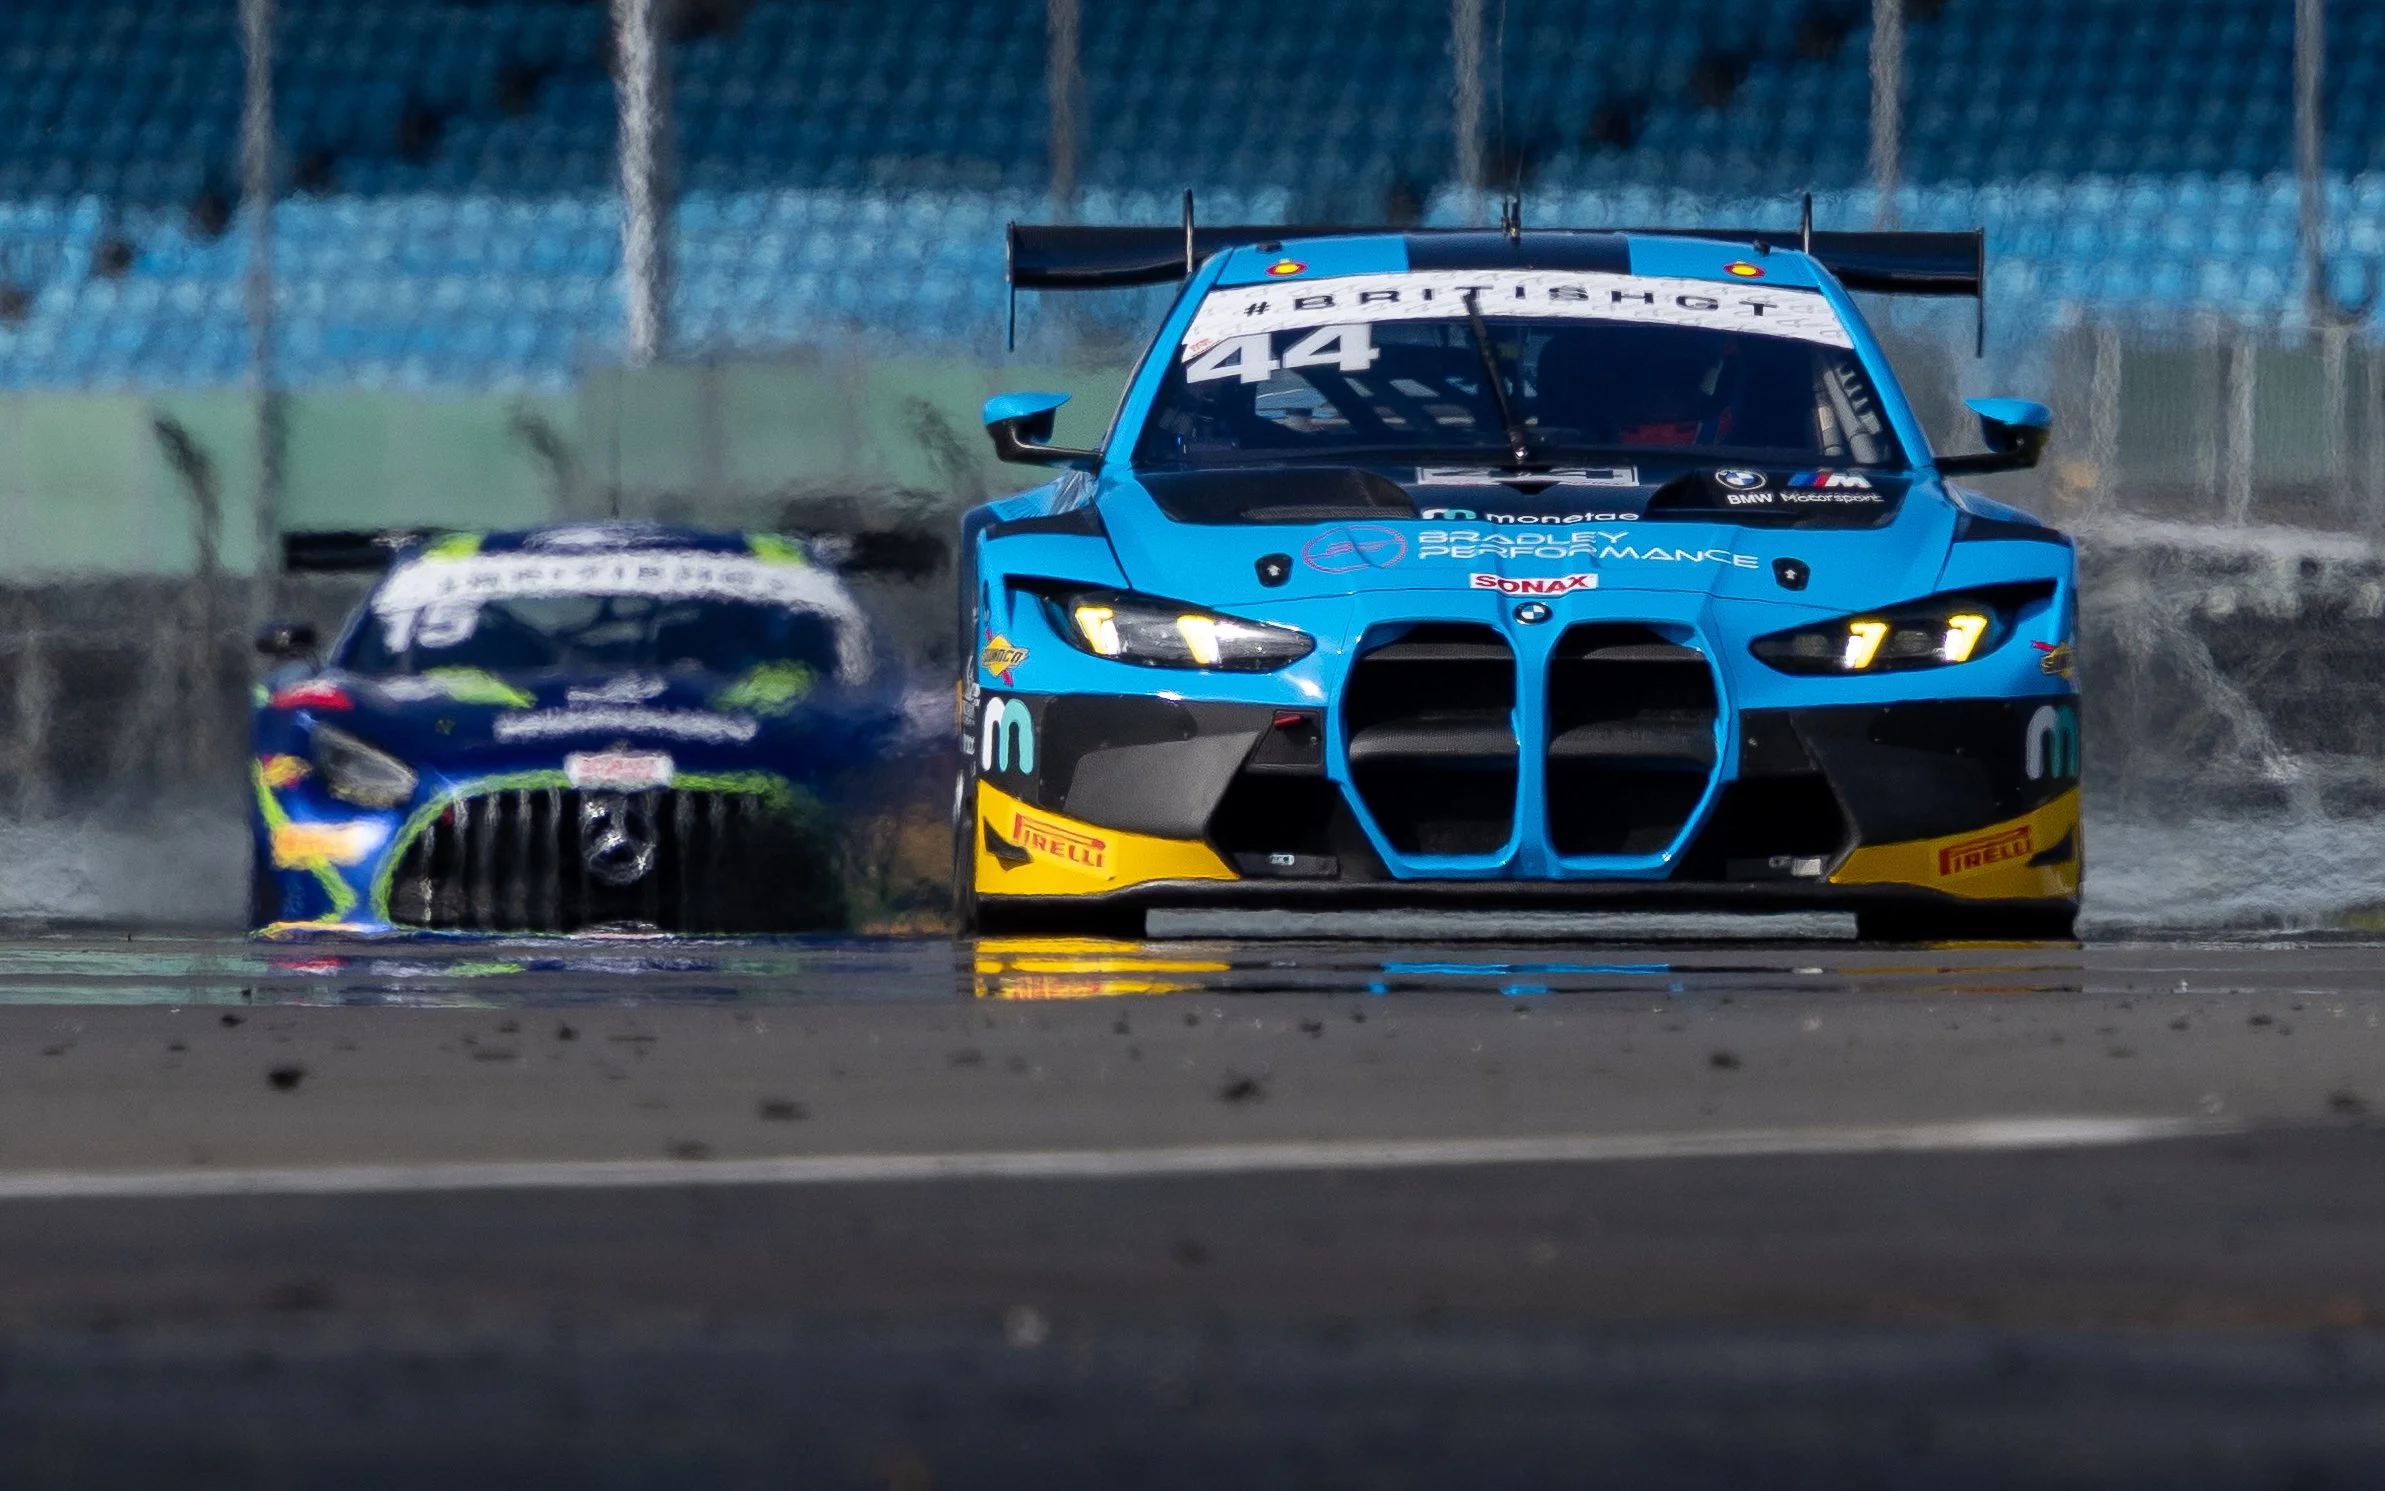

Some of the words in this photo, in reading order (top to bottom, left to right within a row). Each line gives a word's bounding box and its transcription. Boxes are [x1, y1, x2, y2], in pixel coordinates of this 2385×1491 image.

[1242, 284, 1778, 318] #BRITISHGT
[1187, 324, 1380, 385] 44
[1727, 493, 1773, 505] BMW
[1780, 492, 1885, 504] Motorsport
[1485, 511, 1640, 524] monetae
[1418, 530, 1630, 544] BRADLEY
[1418, 545, 1760, 569] PERFORMANCE
[1474, 574, 1589, 595] SONAX
[1013, 812, 1106, 868] PIRELLI
[1939, 825, 2031, 876] PIRELLI
